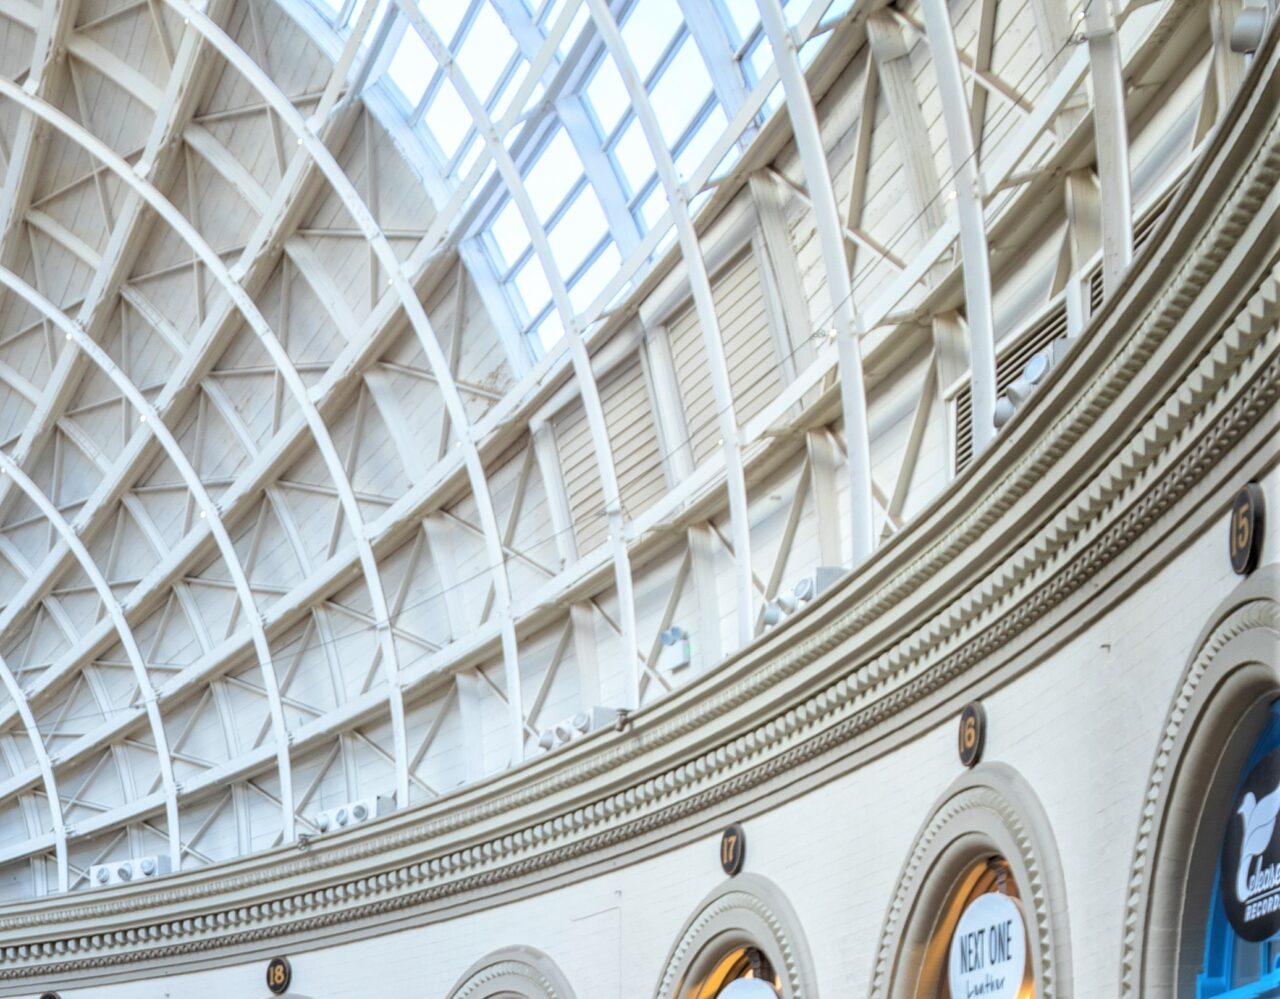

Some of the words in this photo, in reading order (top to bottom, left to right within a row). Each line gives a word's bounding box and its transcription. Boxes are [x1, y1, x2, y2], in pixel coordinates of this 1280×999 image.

[959, 716, 975, 752] 16
[722, 835, 737, 863] 17
[960, 928, 986, 975] NEXT
[988, 920, 1013, 965] ONE
[268, 964, 284, 986] 18
[967, 973, 1006, 999] Leather
